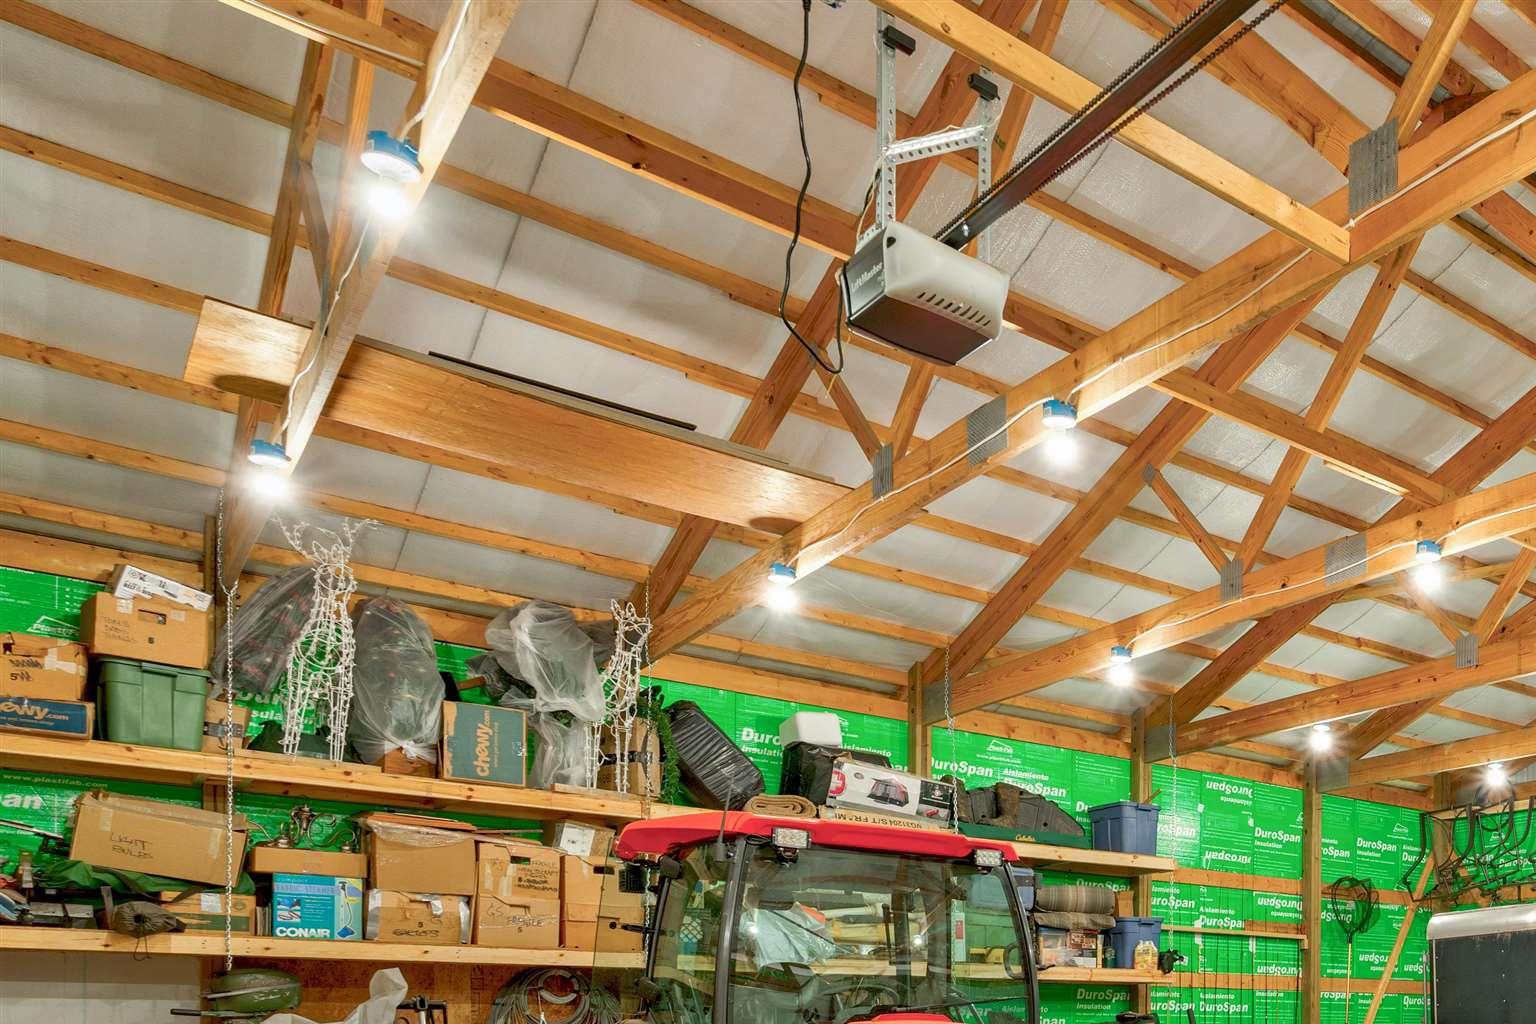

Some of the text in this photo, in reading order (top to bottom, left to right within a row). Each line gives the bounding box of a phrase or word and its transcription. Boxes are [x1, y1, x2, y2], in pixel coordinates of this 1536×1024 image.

[0, 701, 69, 720] ewy.com
[474, 709, 493, 777] chewy.com
[3, 774, 108, 788] www.plastifab.com
[1254, 828, 1300, 843] DuroSpan
[1357, 837, 1397, 851] DuroSpan
[276, 927, 330, 938] CONAIR
[1076, 1002, 1111, 1011] Insulation
[1151, 1000, 1195, 1013] uroSpan
